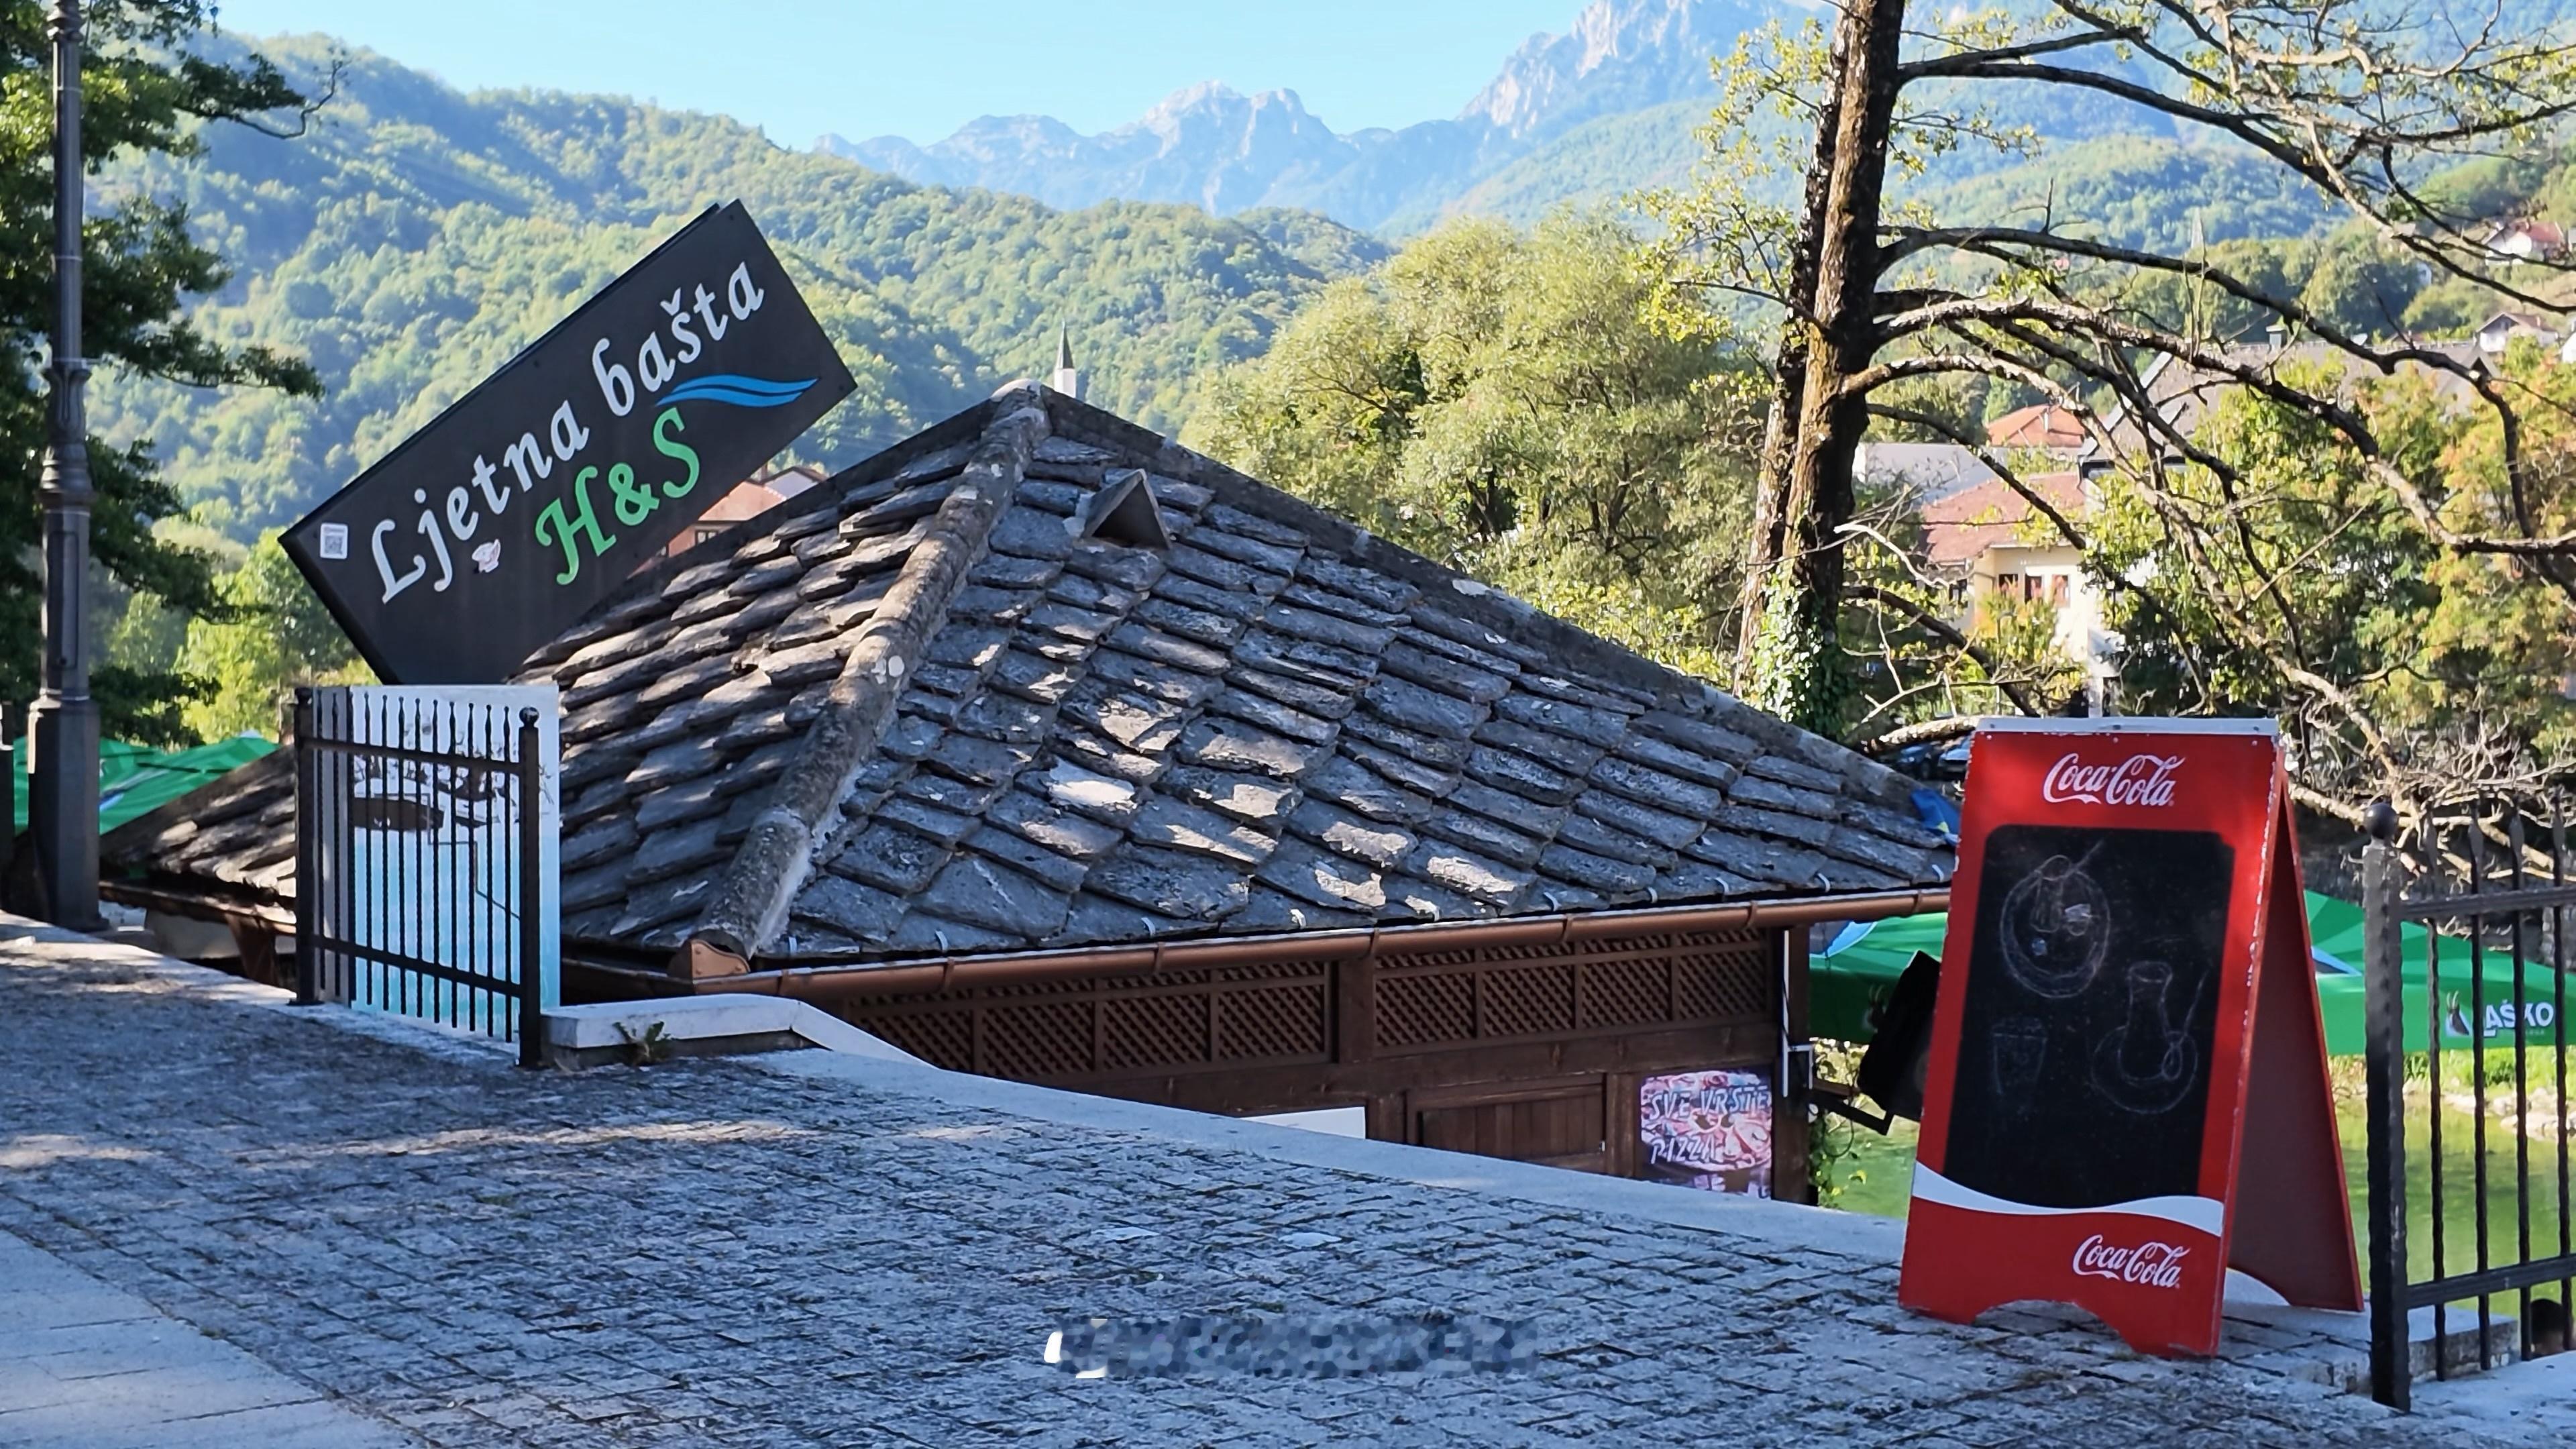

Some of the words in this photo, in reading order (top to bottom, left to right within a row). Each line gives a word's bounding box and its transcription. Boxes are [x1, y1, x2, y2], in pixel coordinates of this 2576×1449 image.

[371, 400, 591, 605] Ljetna
[591, 260, 765, 418] bašta
[534, 406, 700, 585] H&S
[1649, 1092, 1690, 1120] SVE
[1650, 1134, 1716, 1165] PIZZA
